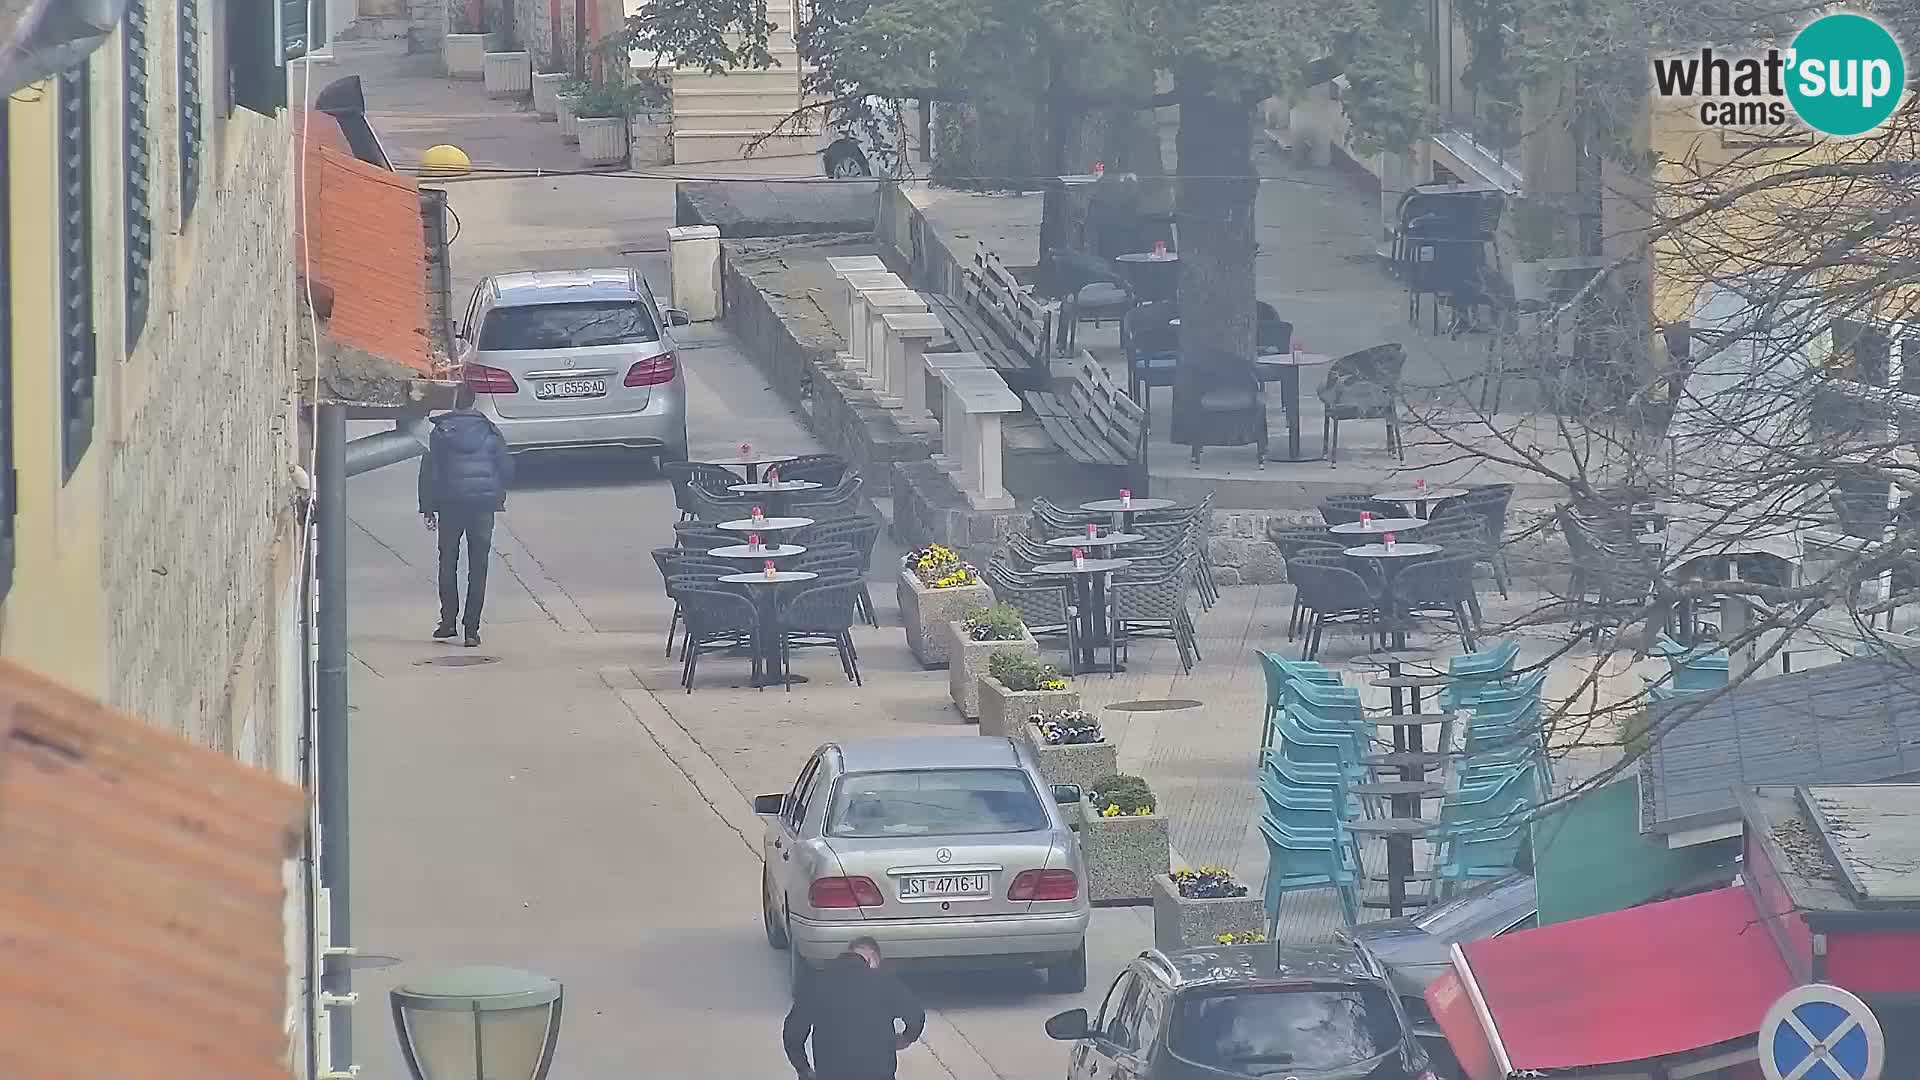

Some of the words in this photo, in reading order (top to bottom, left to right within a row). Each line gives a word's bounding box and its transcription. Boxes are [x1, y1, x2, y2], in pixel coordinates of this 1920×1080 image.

[545, 383, 557, 394] ST
[911, 879, 927, 893] ST
[936, 875, 983, 892] 4716-U
